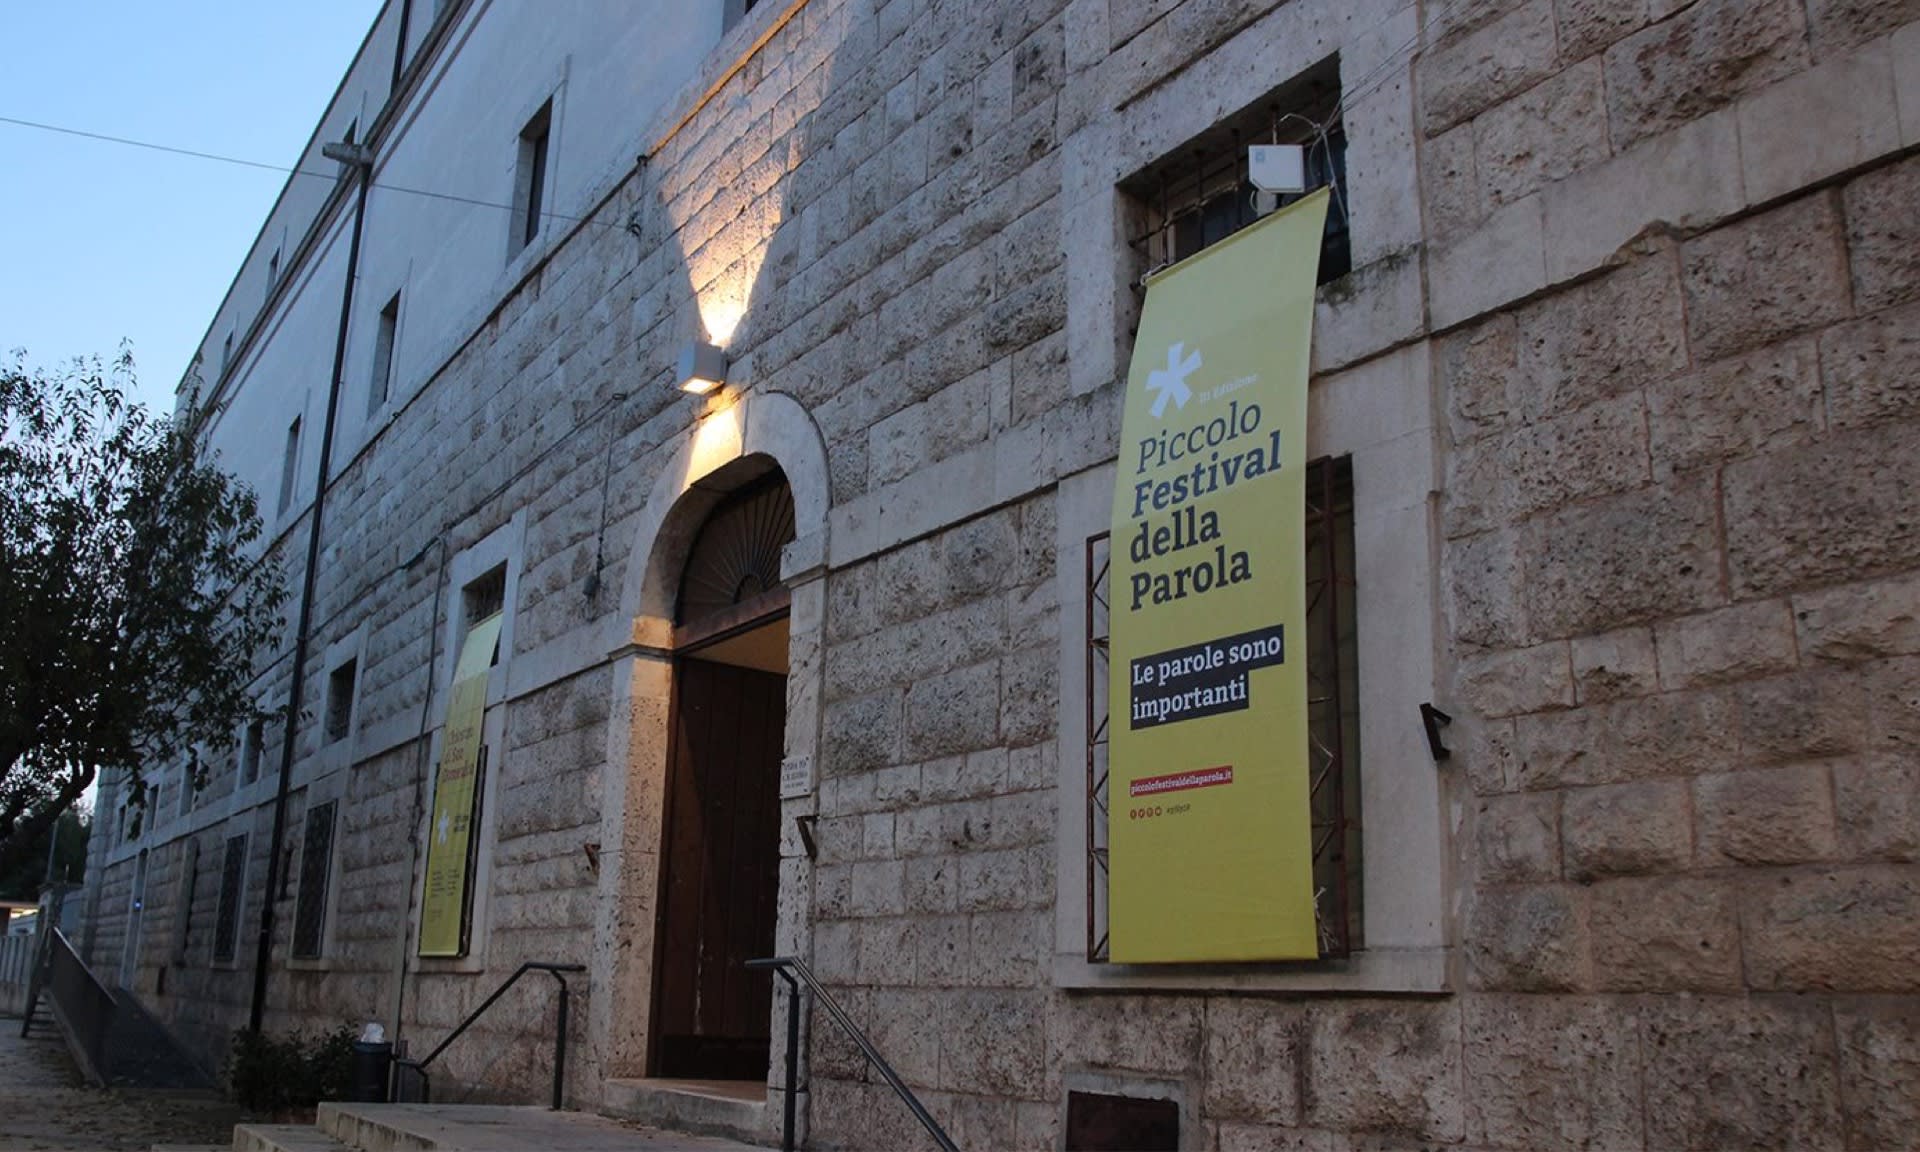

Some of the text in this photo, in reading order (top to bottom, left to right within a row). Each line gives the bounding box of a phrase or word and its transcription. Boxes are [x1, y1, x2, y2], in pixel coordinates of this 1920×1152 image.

[1136, 400, 1261, 474] Piccolo
[1131, 429, 1281, 518] Festival
[1130, 505, 1221, 563] della
[1130, 545, 1252, 611] Parola
[1133, 635, 1281, 687] Le parole sono
[1132, 674, 1246, 721] importanti
[1131, 768, 1232, 796] piccolofestivaldellaparola.it
